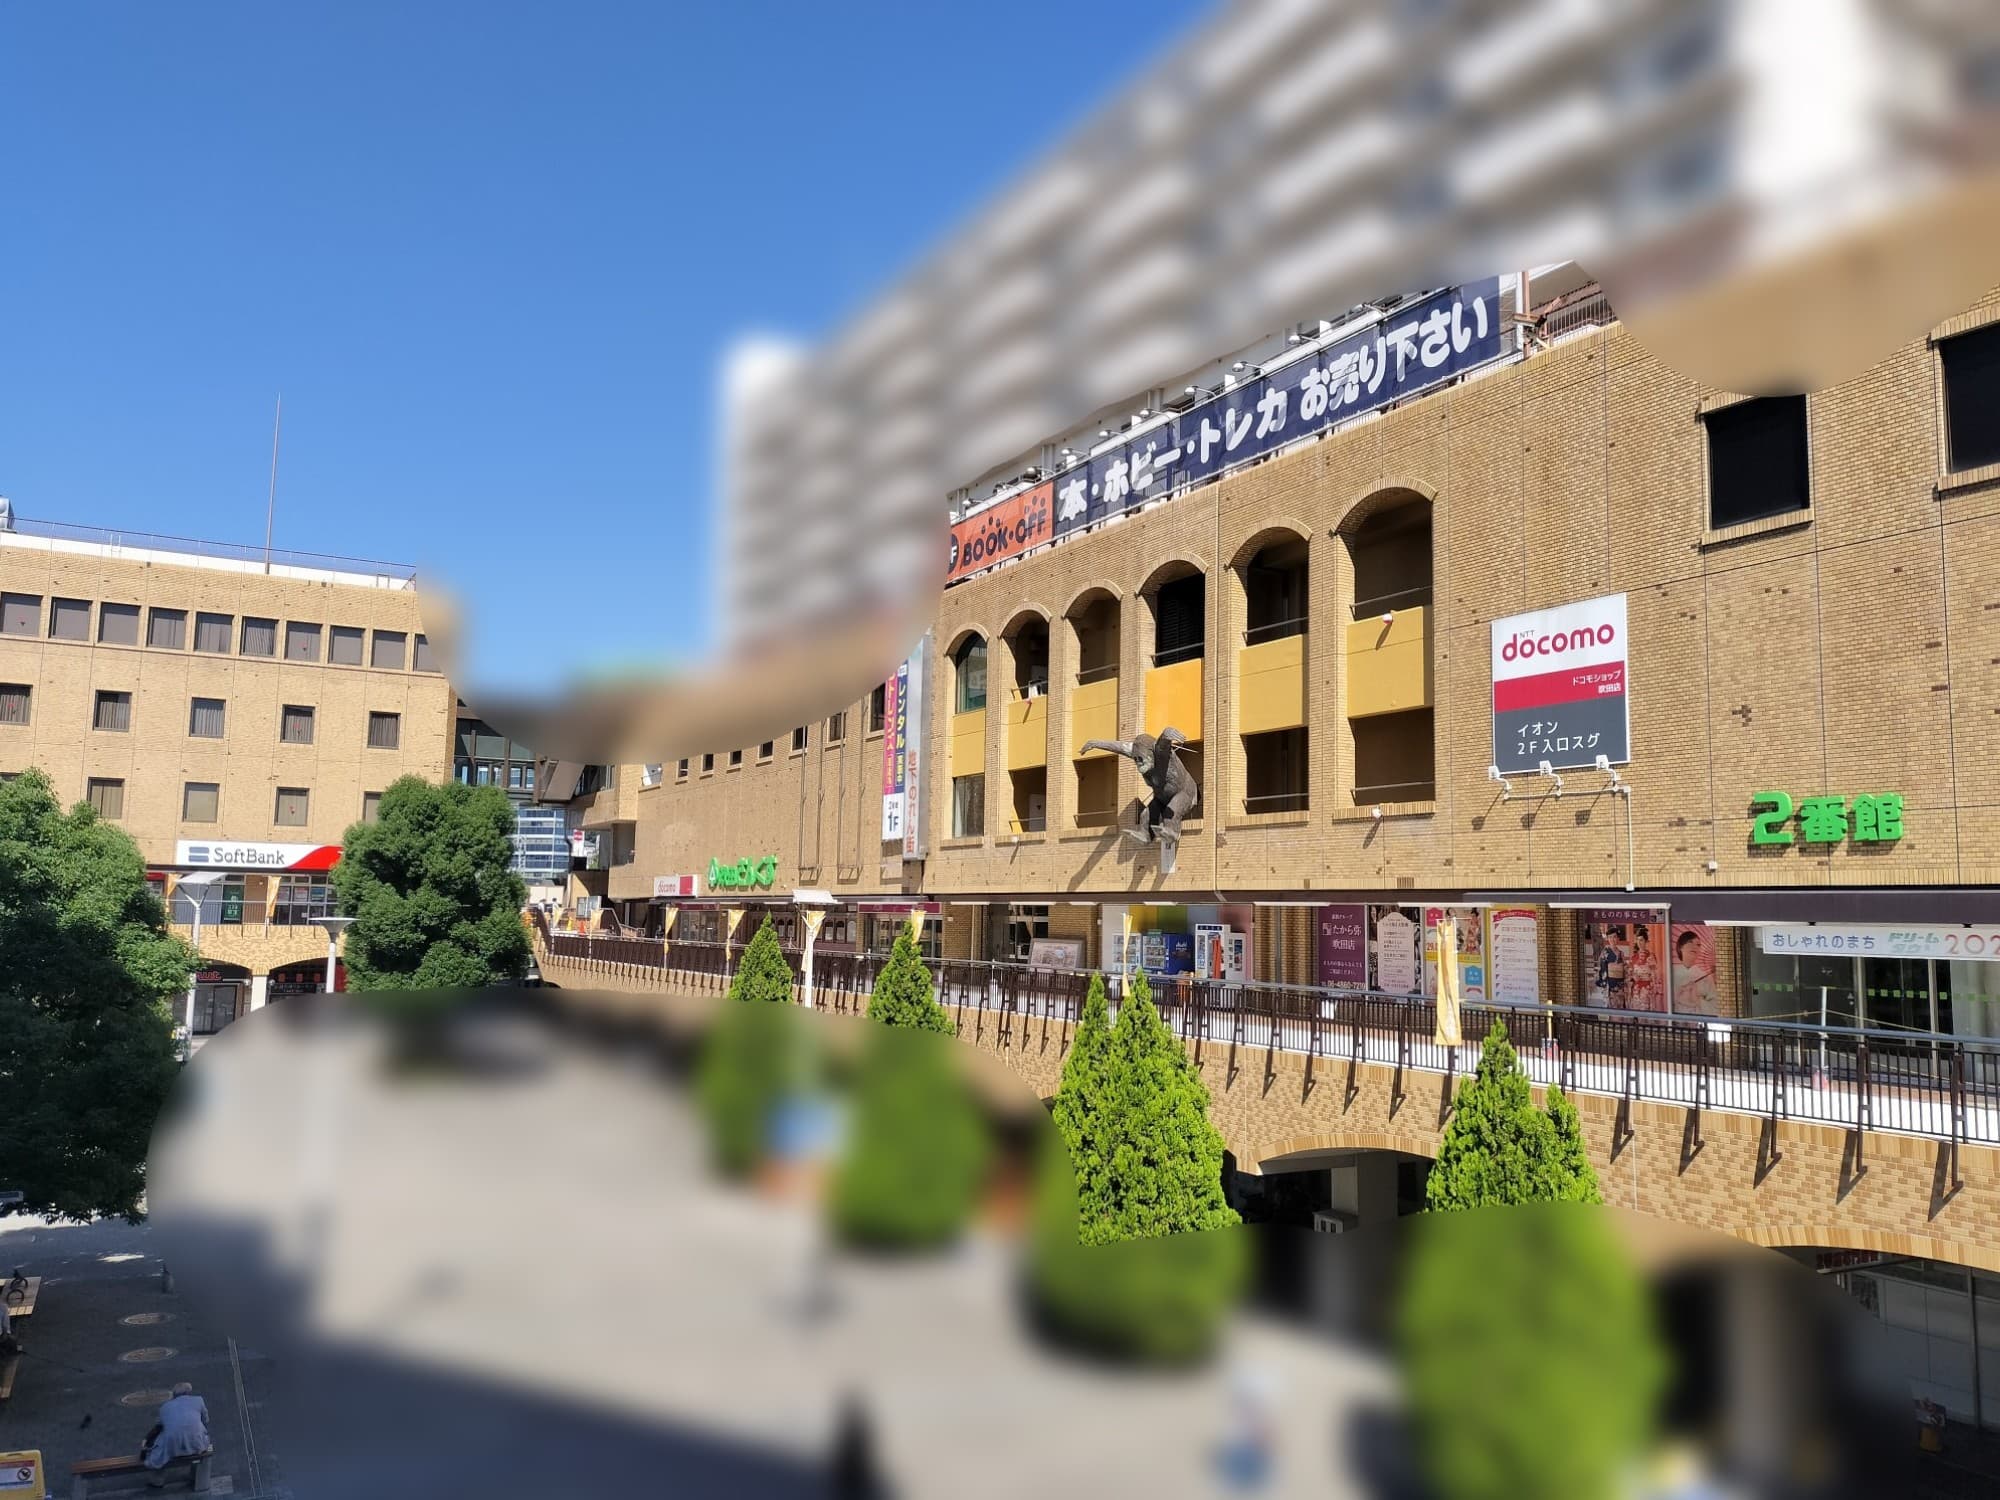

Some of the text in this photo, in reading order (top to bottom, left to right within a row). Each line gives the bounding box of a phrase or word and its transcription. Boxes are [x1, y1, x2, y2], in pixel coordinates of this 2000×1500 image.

[1300, 297, 1488, 421] お売り下さい
[1502, 624, 1615, 662] docomo
[1519, 630, 1535, 638] NTT
[1572, 671, 1621, 686] ドコモショップ
[896, 681, 906, 749] レンタル
[1517, 721, 1559, 738] イオン
[1752, 791, 1904, 845] 2番館
[213, 847, 285, 865] SoftBank
[1772, 933, 1876, 950] おしゃれのまち
